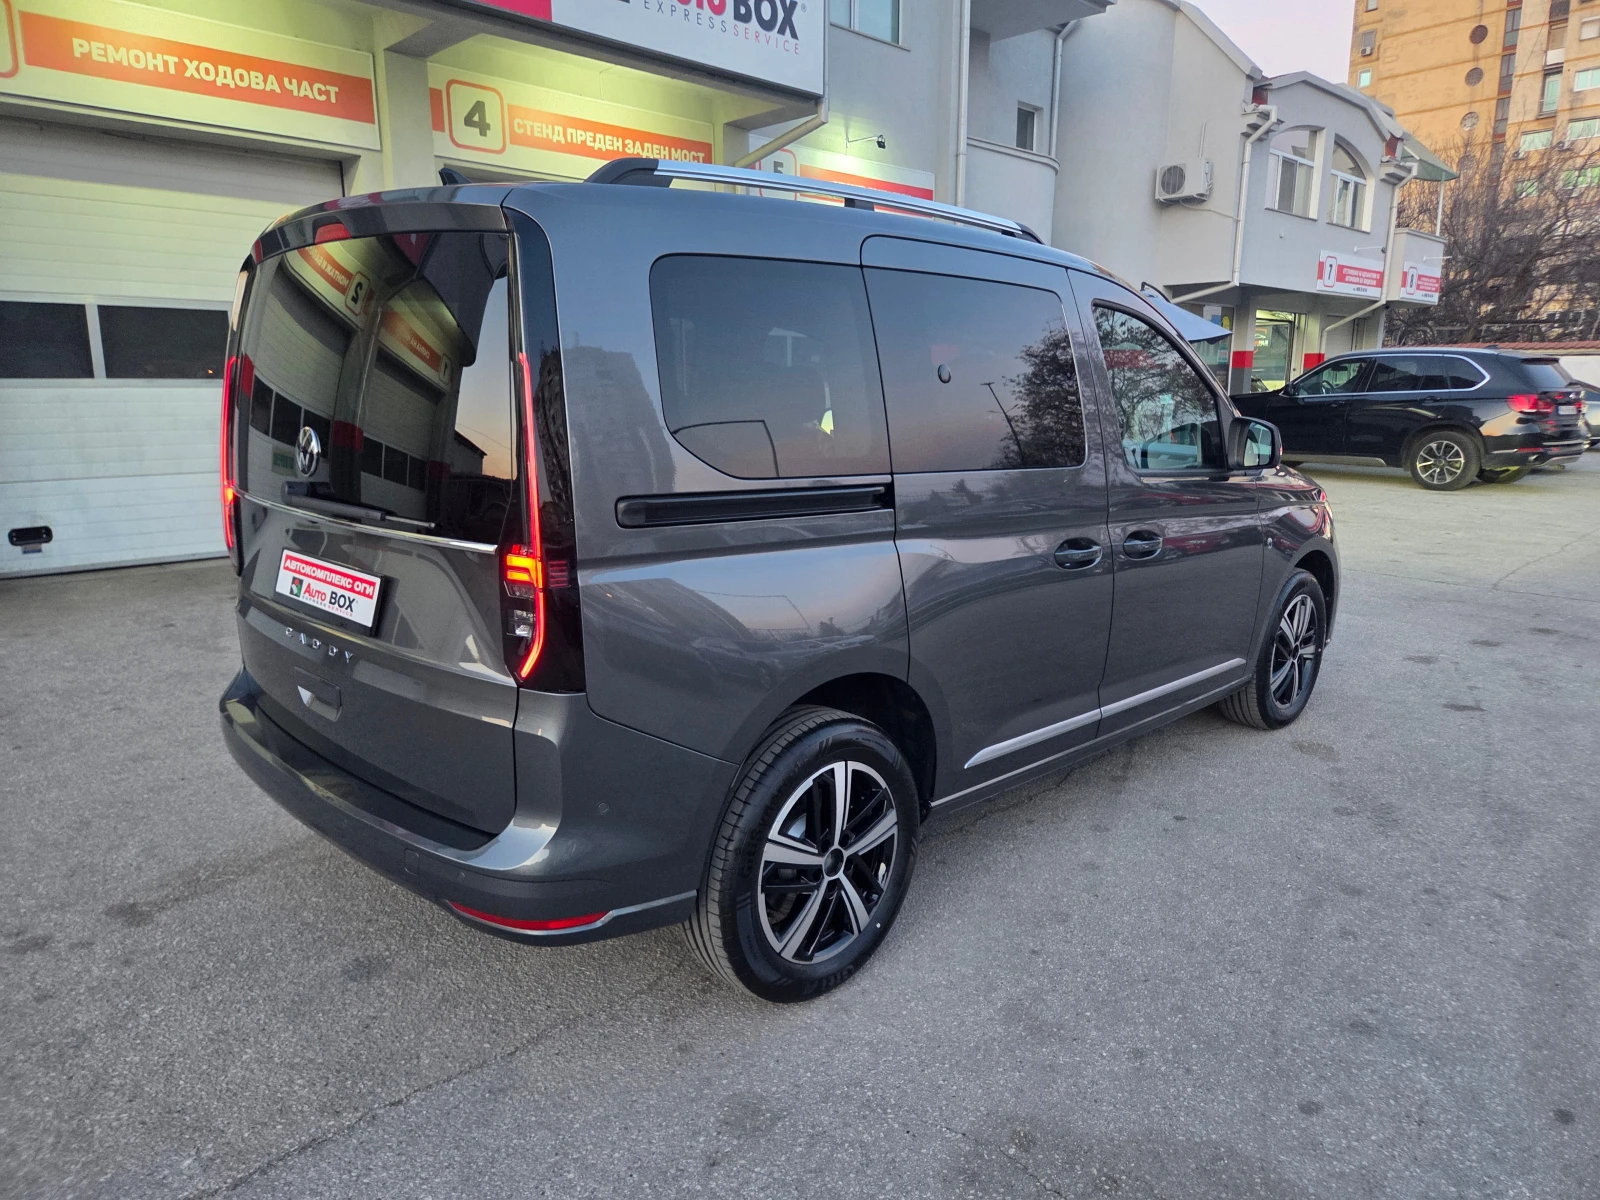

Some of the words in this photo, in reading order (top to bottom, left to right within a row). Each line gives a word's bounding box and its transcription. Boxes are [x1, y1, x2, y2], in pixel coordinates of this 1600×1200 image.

[644, 0, 727, 33] EXPRESS
[733, 25, 800, 55] SERVICE
[734, 0, 800, 40] BOX
[72, 37, 179, 75] РЕМОНТ
[183, 58, 281, 94] ХОДОВА
[283, 79, 340, 104] ЧАСТ
[463, 100, 491, 137] 4
[513, 118, 565, 144] СТЕНД
[566, 127, 623, 152] ПРЕДЕН
[624, 138, 669, 160] ЗАДЕН
[671, 149, 705, 164] МОСТ
[1327, 263, 1333, 280] 7
[1409, 273, 1415, 288] 8
[284, 559, 353, 589] АВТОКОМПЛЕКС
[354, 581, 374, 596] ОГИ
[329, 591, 356, 613] BOX
